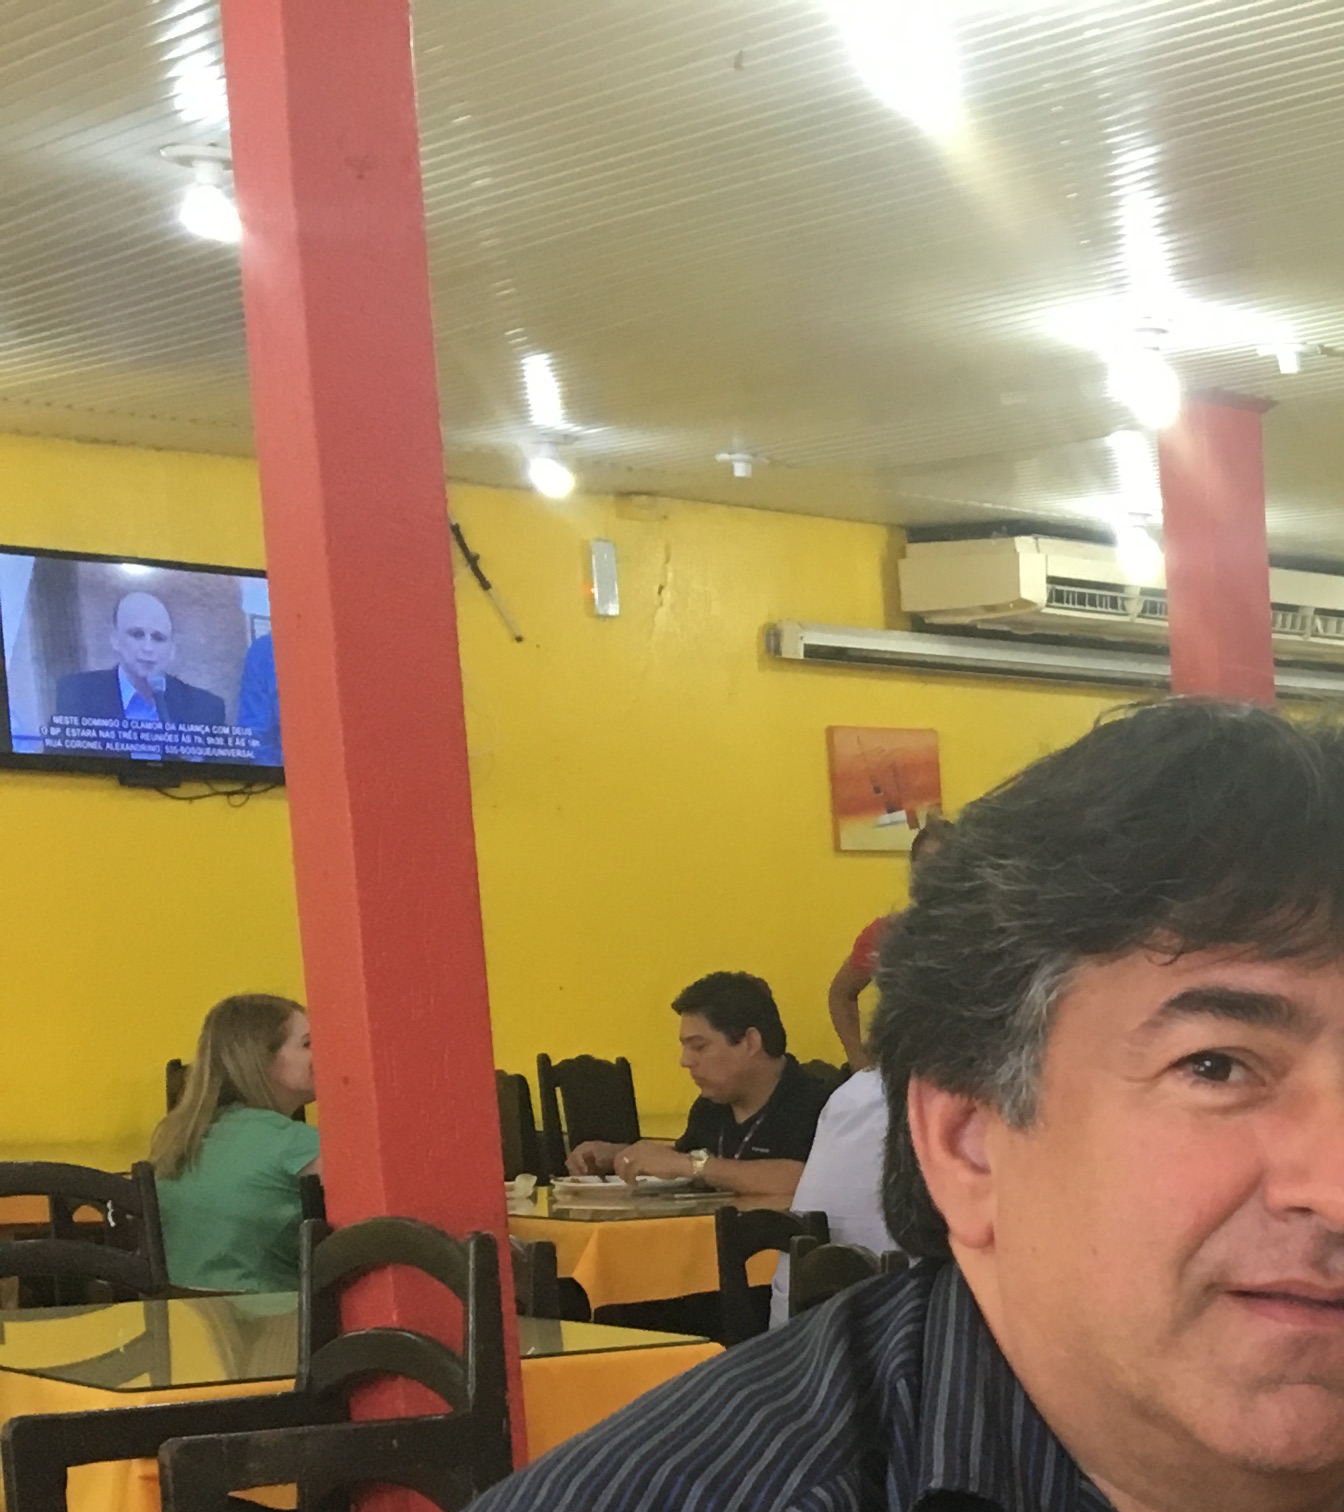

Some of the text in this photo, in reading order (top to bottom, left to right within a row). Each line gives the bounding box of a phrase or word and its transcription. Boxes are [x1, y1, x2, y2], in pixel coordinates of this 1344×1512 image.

[52, 715, 79, 726] NESTE
[81, 717, 120, 728] DOMINGO
[130, 720, 163, 730] CLAMOR
[211, 725, 230, 734] COM
[231, 726, 253, 736] DEUS
[98, 729, 116, 739] NAS
[44, 738, 63, 748] RUA
[64, 739, 103, 750] CORONEL
